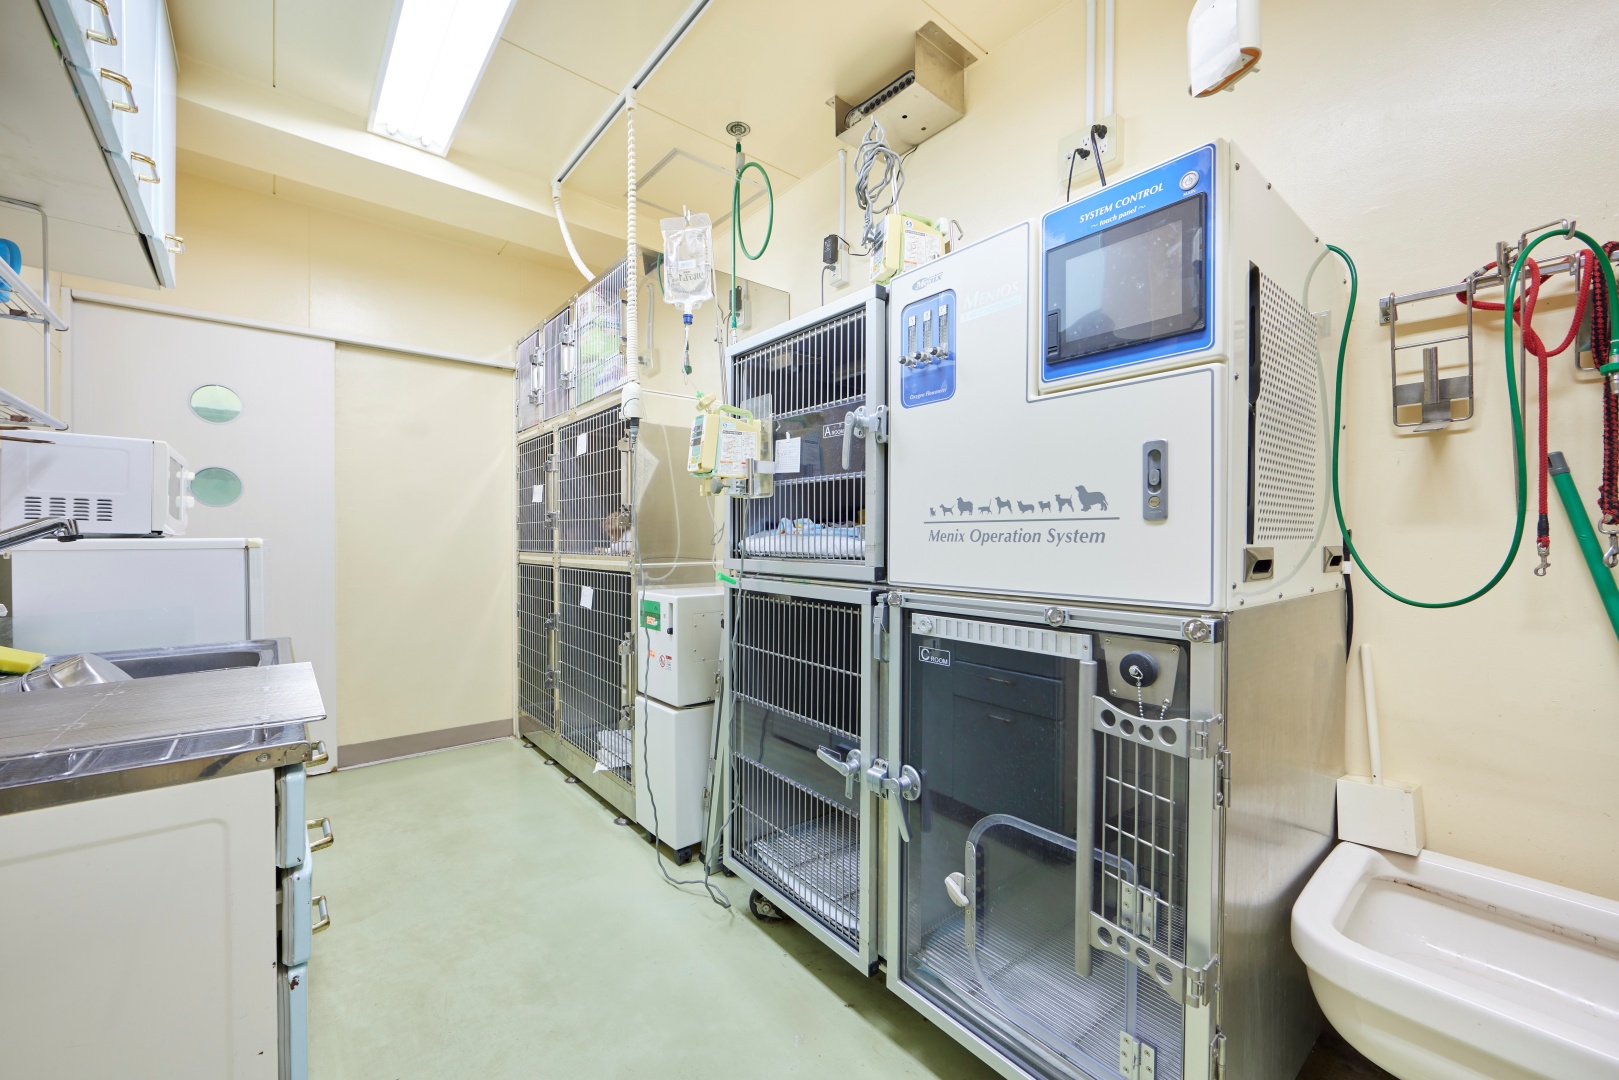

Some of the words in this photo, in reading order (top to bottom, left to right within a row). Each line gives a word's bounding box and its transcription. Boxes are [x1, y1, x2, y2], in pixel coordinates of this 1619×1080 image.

[1079, 203, 1113, 223] SYSTEM
[1115, 182, 1164, 209] CONTROL
[1099, 213, 1117, 226] touch
[1118, 206, 1137, 221] panel
[824, 426, 831, 437] A
[929, 528, 965, 543] Menix
[969, 527, 1042, 546] Operation
[1046, 527, 1106, 547] System
[921, 648, 930, 661] C
[930, 656, 948, 665] ROOM
